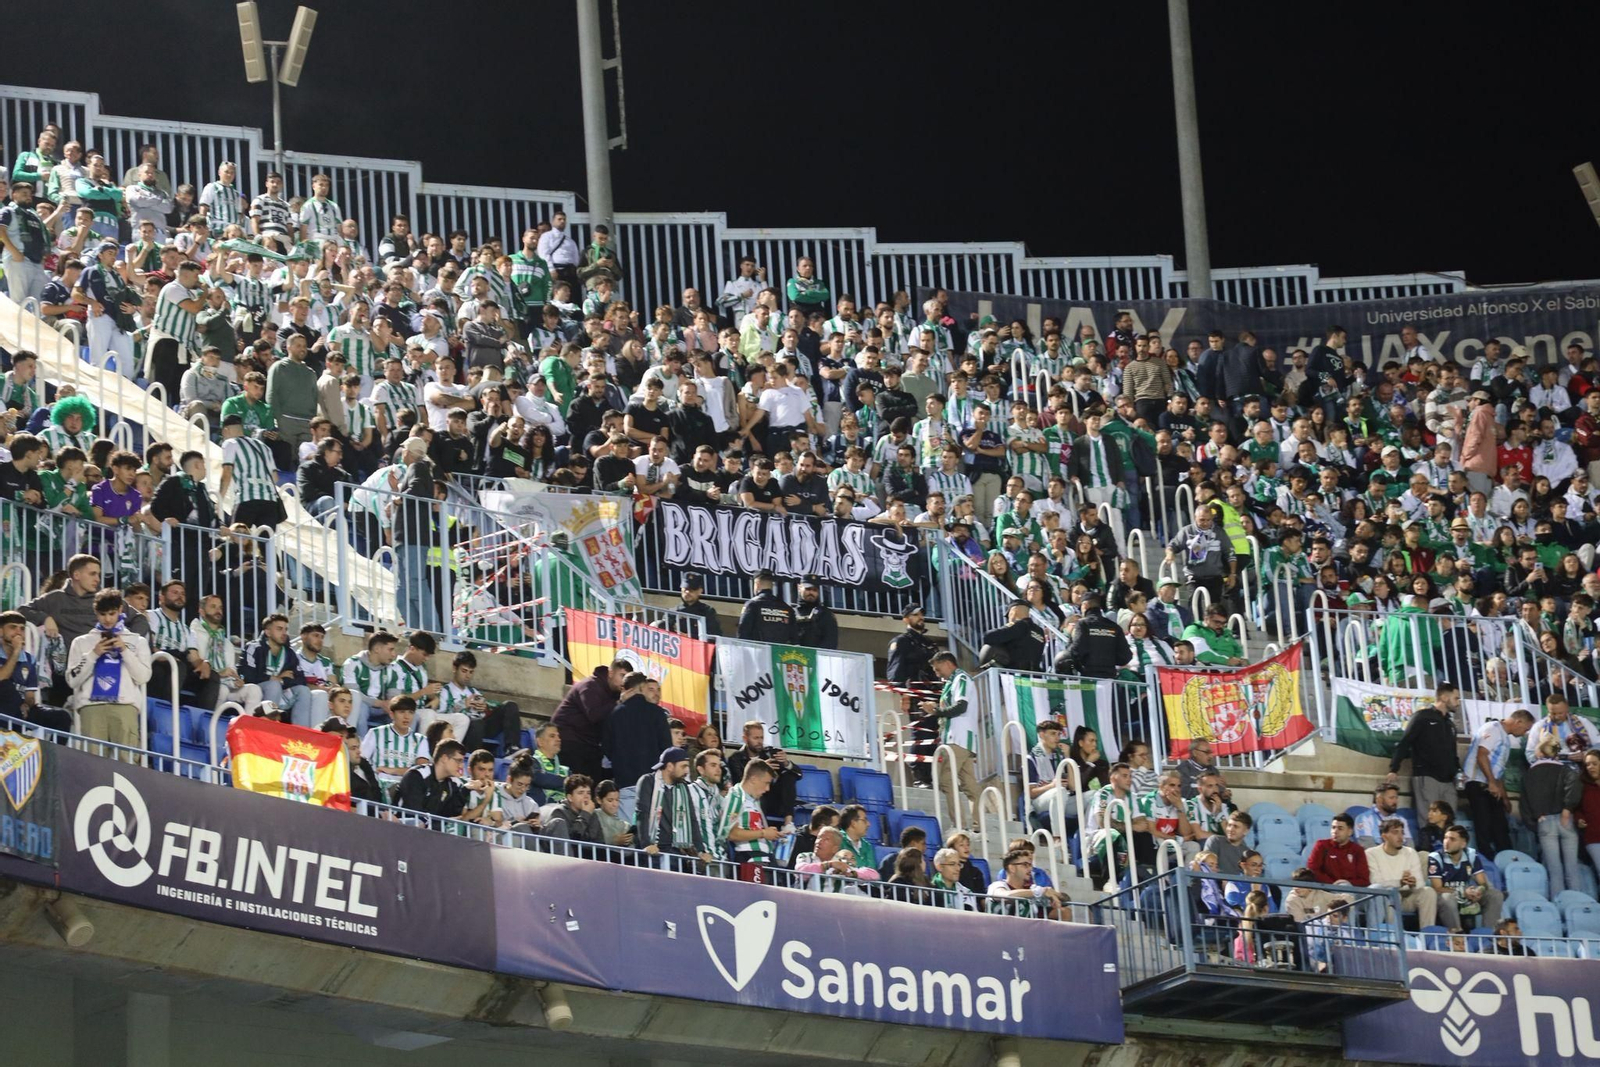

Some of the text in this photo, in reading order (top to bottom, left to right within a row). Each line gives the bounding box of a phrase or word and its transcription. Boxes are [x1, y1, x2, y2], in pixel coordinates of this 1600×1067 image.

[1367, 303, 1464, 325] Universidad
[1467, 300, 1529, 316] Alfonso
[1532, 298, 1543, 312] X
[1546, 297, 1561, 311] el
[661, 501, 868, 585] BRIGADAS
[596, 616, 681, 659] DE PADRES
[820, 678, 861, 713] 1960
[761, 720, 845, 744] ÓRDOBA
[157, 821, 383, 918] FB.INTEC
[157, 884, 378, 936] INGENIERÍA E INSTALACIONES TÉCNICAS
[781, 940, 1031, 1023] Sanamar
